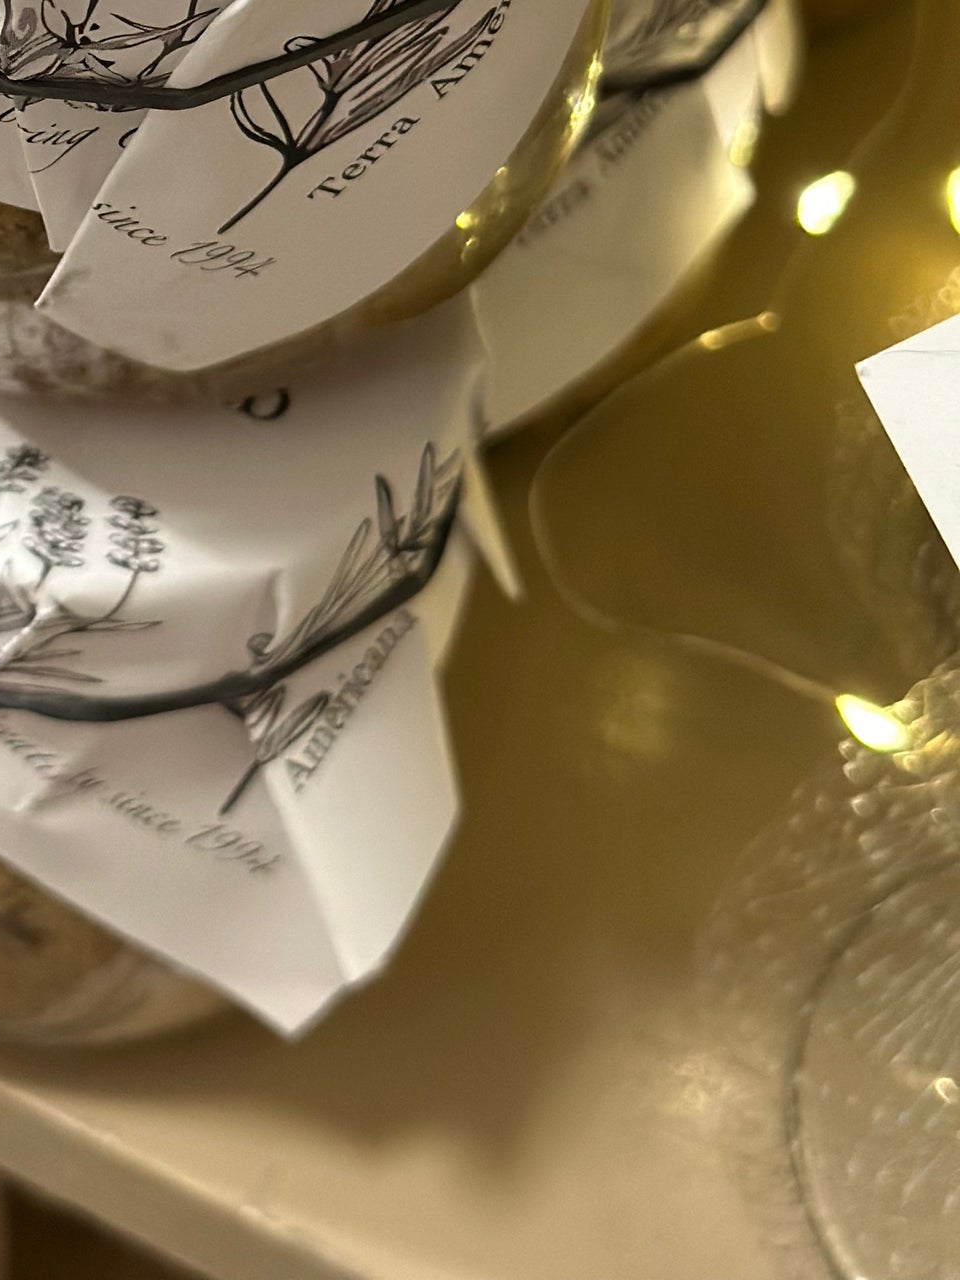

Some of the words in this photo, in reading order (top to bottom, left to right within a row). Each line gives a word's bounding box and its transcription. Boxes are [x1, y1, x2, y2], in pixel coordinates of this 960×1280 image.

[307, 115, 422, 198] Terra
[92, 203, 167, 246] since
[170, 241, 277, 278] 1994
[286, 608, 418, 794] Americana
